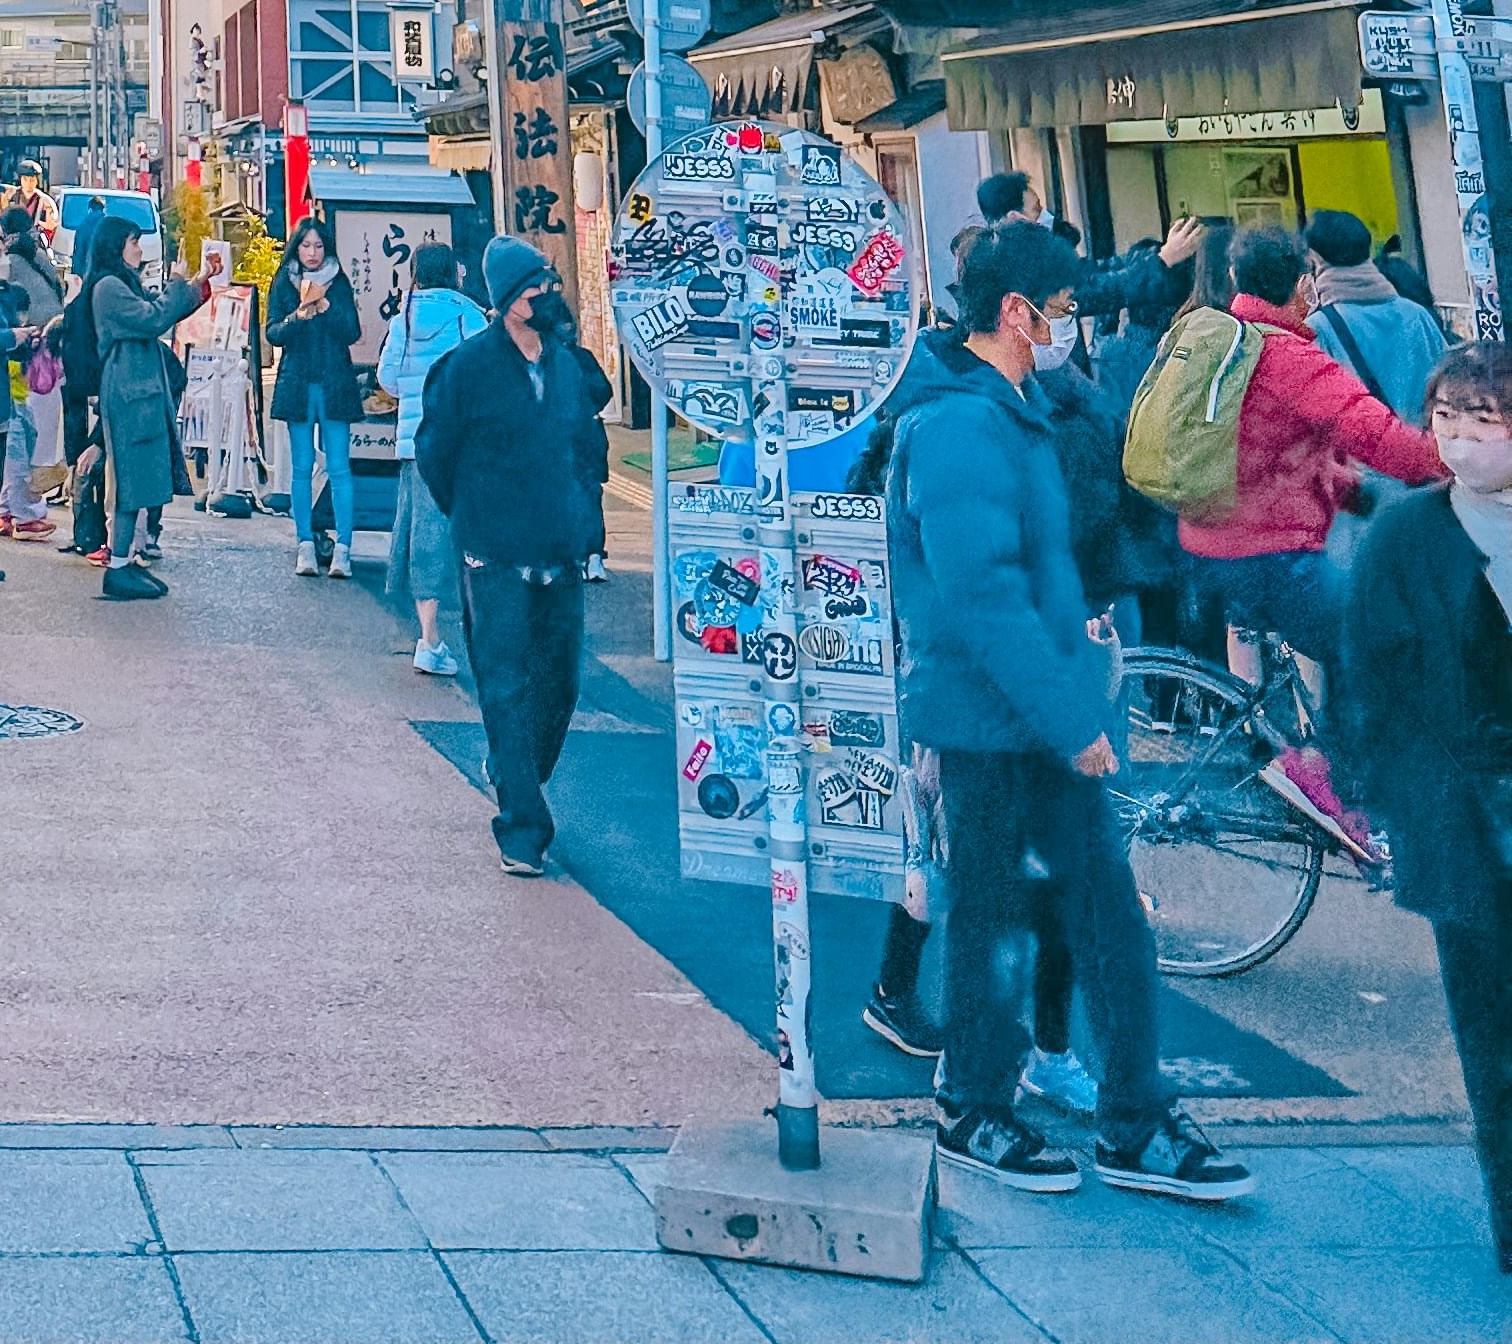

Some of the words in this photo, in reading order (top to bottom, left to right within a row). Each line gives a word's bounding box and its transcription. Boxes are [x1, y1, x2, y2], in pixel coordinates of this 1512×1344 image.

[508, 34, 566, 234] 伝法院
[670, 157, 734, 179] JESS3
[791, 223, 856, 252] JESS3
[632, 296, 686, 343] BILO
[790, 307, 838, 327] SMOKE
[812, 496, 881, 519] JESS3
